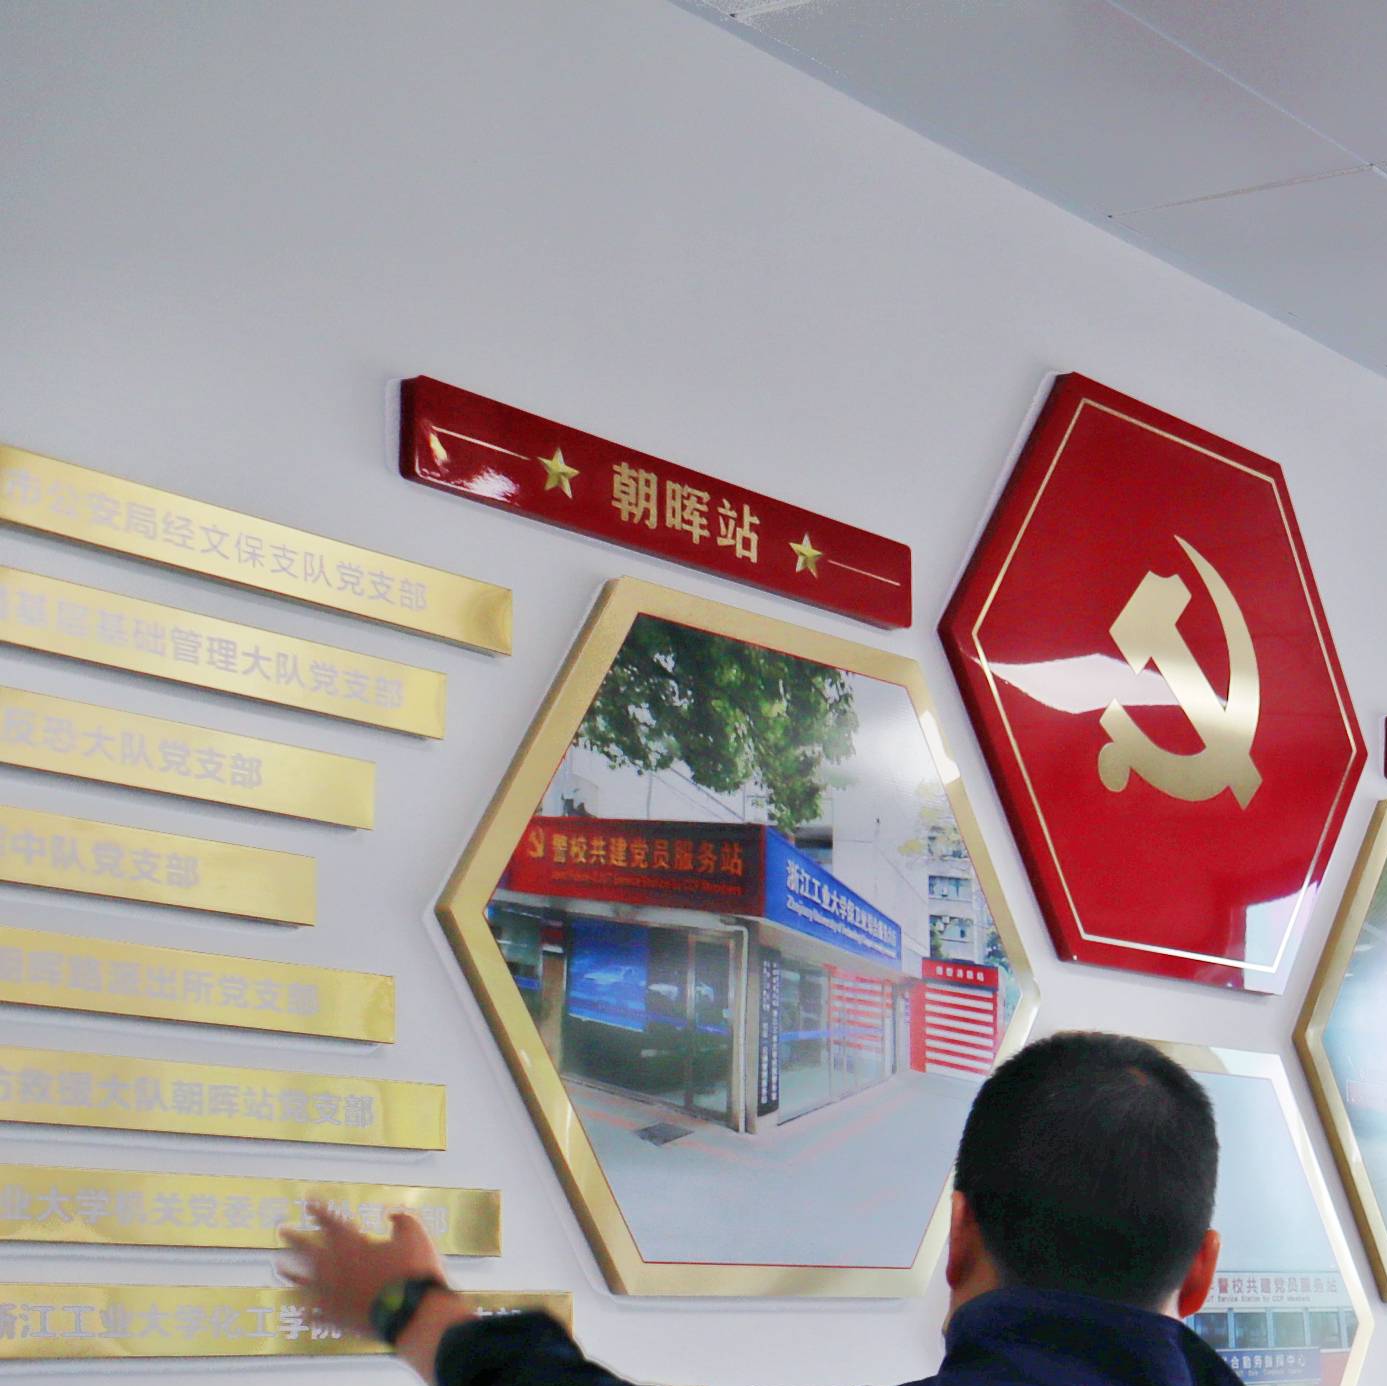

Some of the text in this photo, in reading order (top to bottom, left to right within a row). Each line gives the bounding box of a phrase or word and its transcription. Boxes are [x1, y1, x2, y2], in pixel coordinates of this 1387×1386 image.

[611, 462, 760, 564] 朝晖站
[552, 832, 744, 877] 警校共建党员服务站
[1223, 1353, 1306, 1369] 合勤务指挥中心
